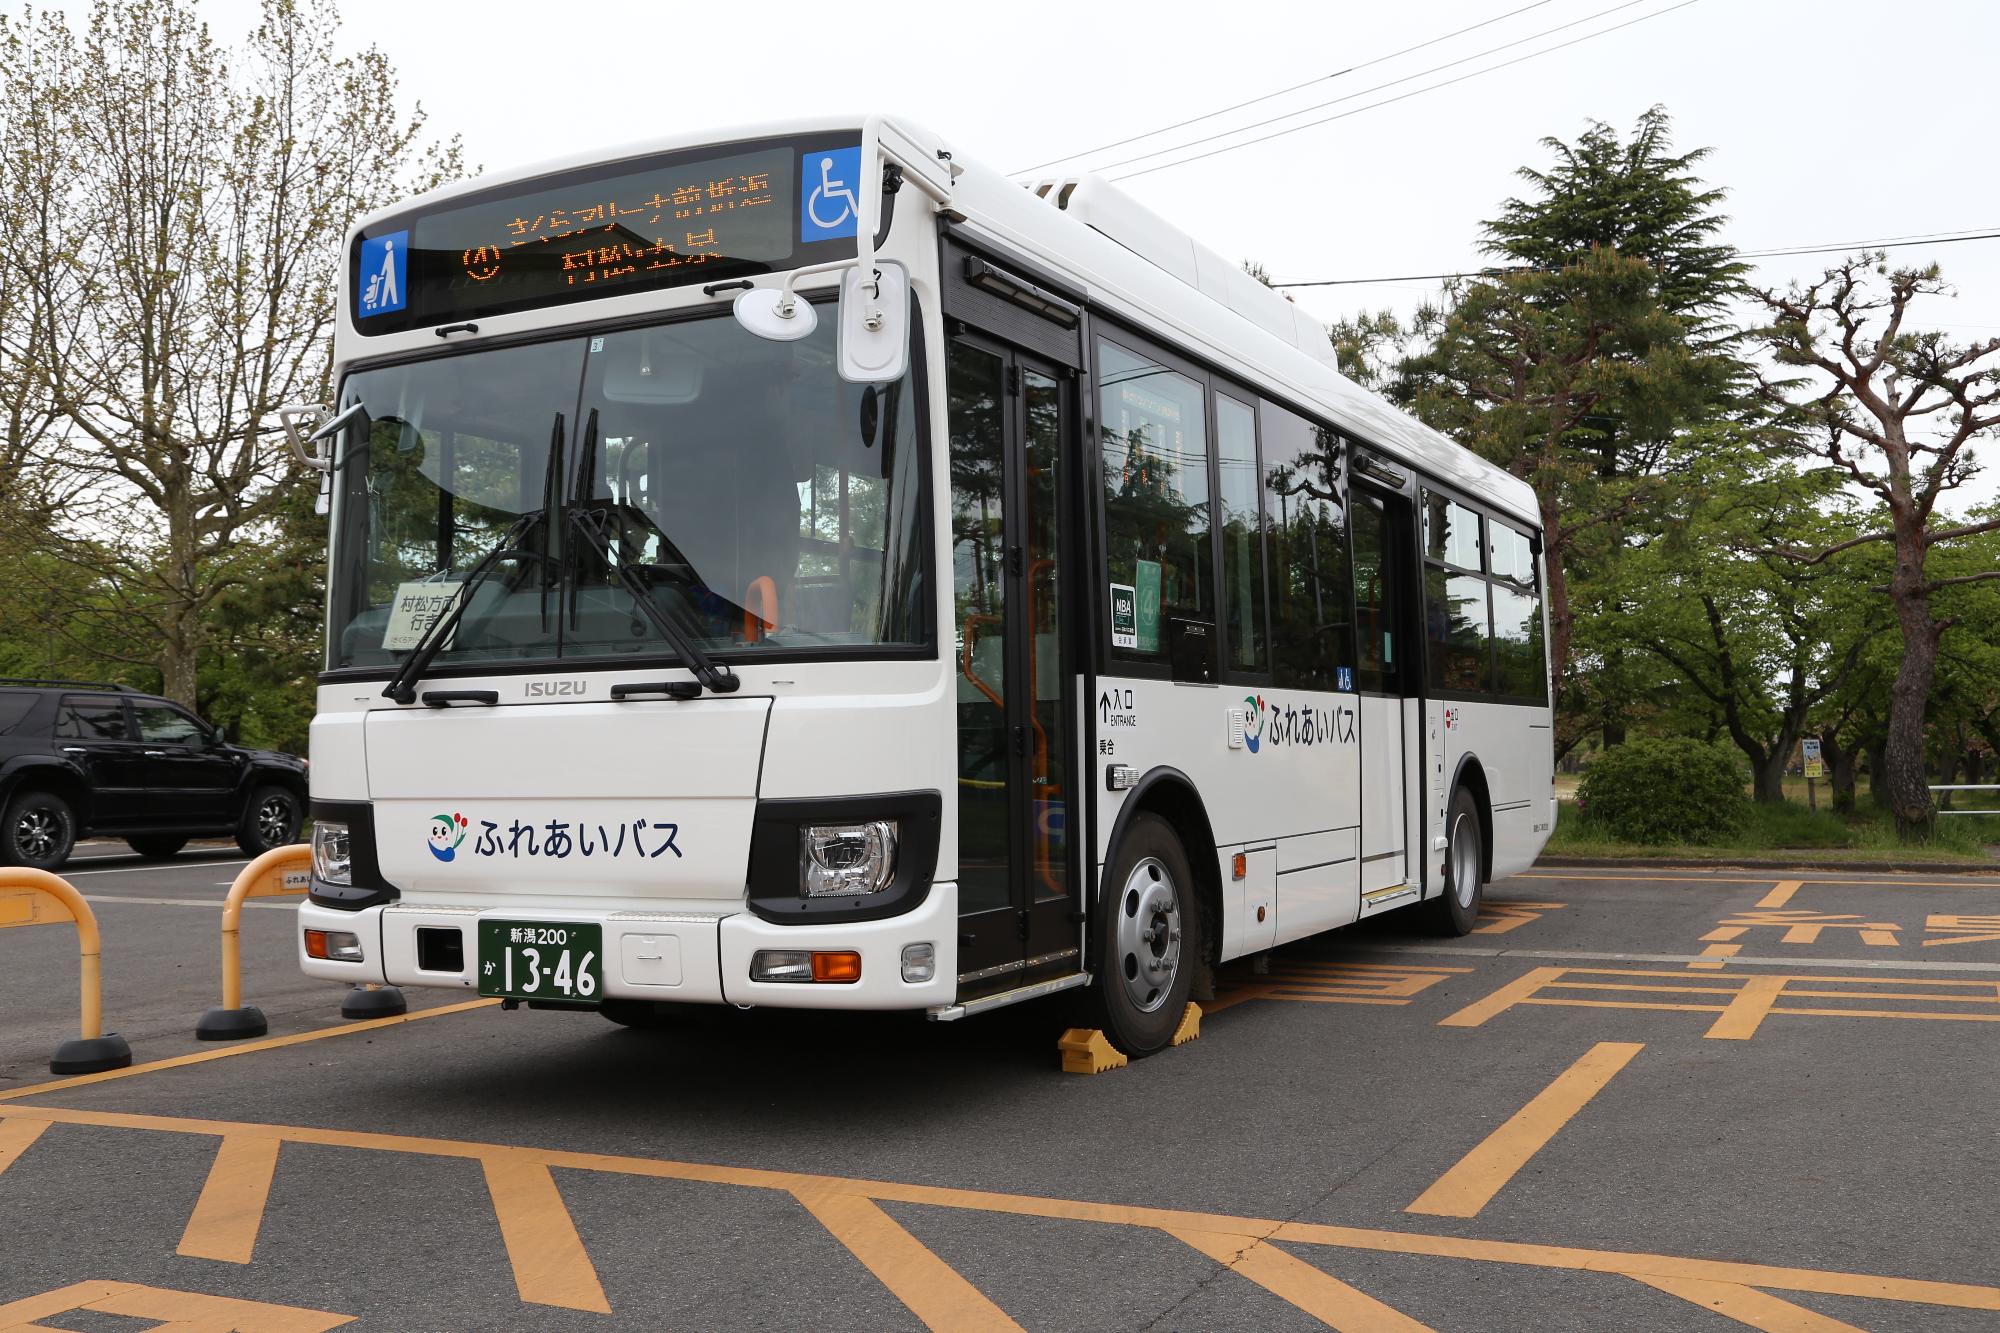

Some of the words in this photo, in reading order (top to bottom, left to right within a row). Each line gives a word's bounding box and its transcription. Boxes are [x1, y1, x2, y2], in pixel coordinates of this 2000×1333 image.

[400, 594, 457, 613] 村松方面
[1116, 598, 1132, 614] NBA
[524, 680, 587, 698] ISUZU
[1113, 688, 1134, 711] 入口
[1110, 714, 1137, 728] ENTRANCE
[1268, 702, 1356, 747] ふれあいバス
[1099, 738, 1115, 756] 乗合
[475, 818, 684, 860] ふれあいバス
[509, 927, 568, 946] 新潟200
[483, 960, 498, 977] か
[504, 945, 597, 997] 13-46
